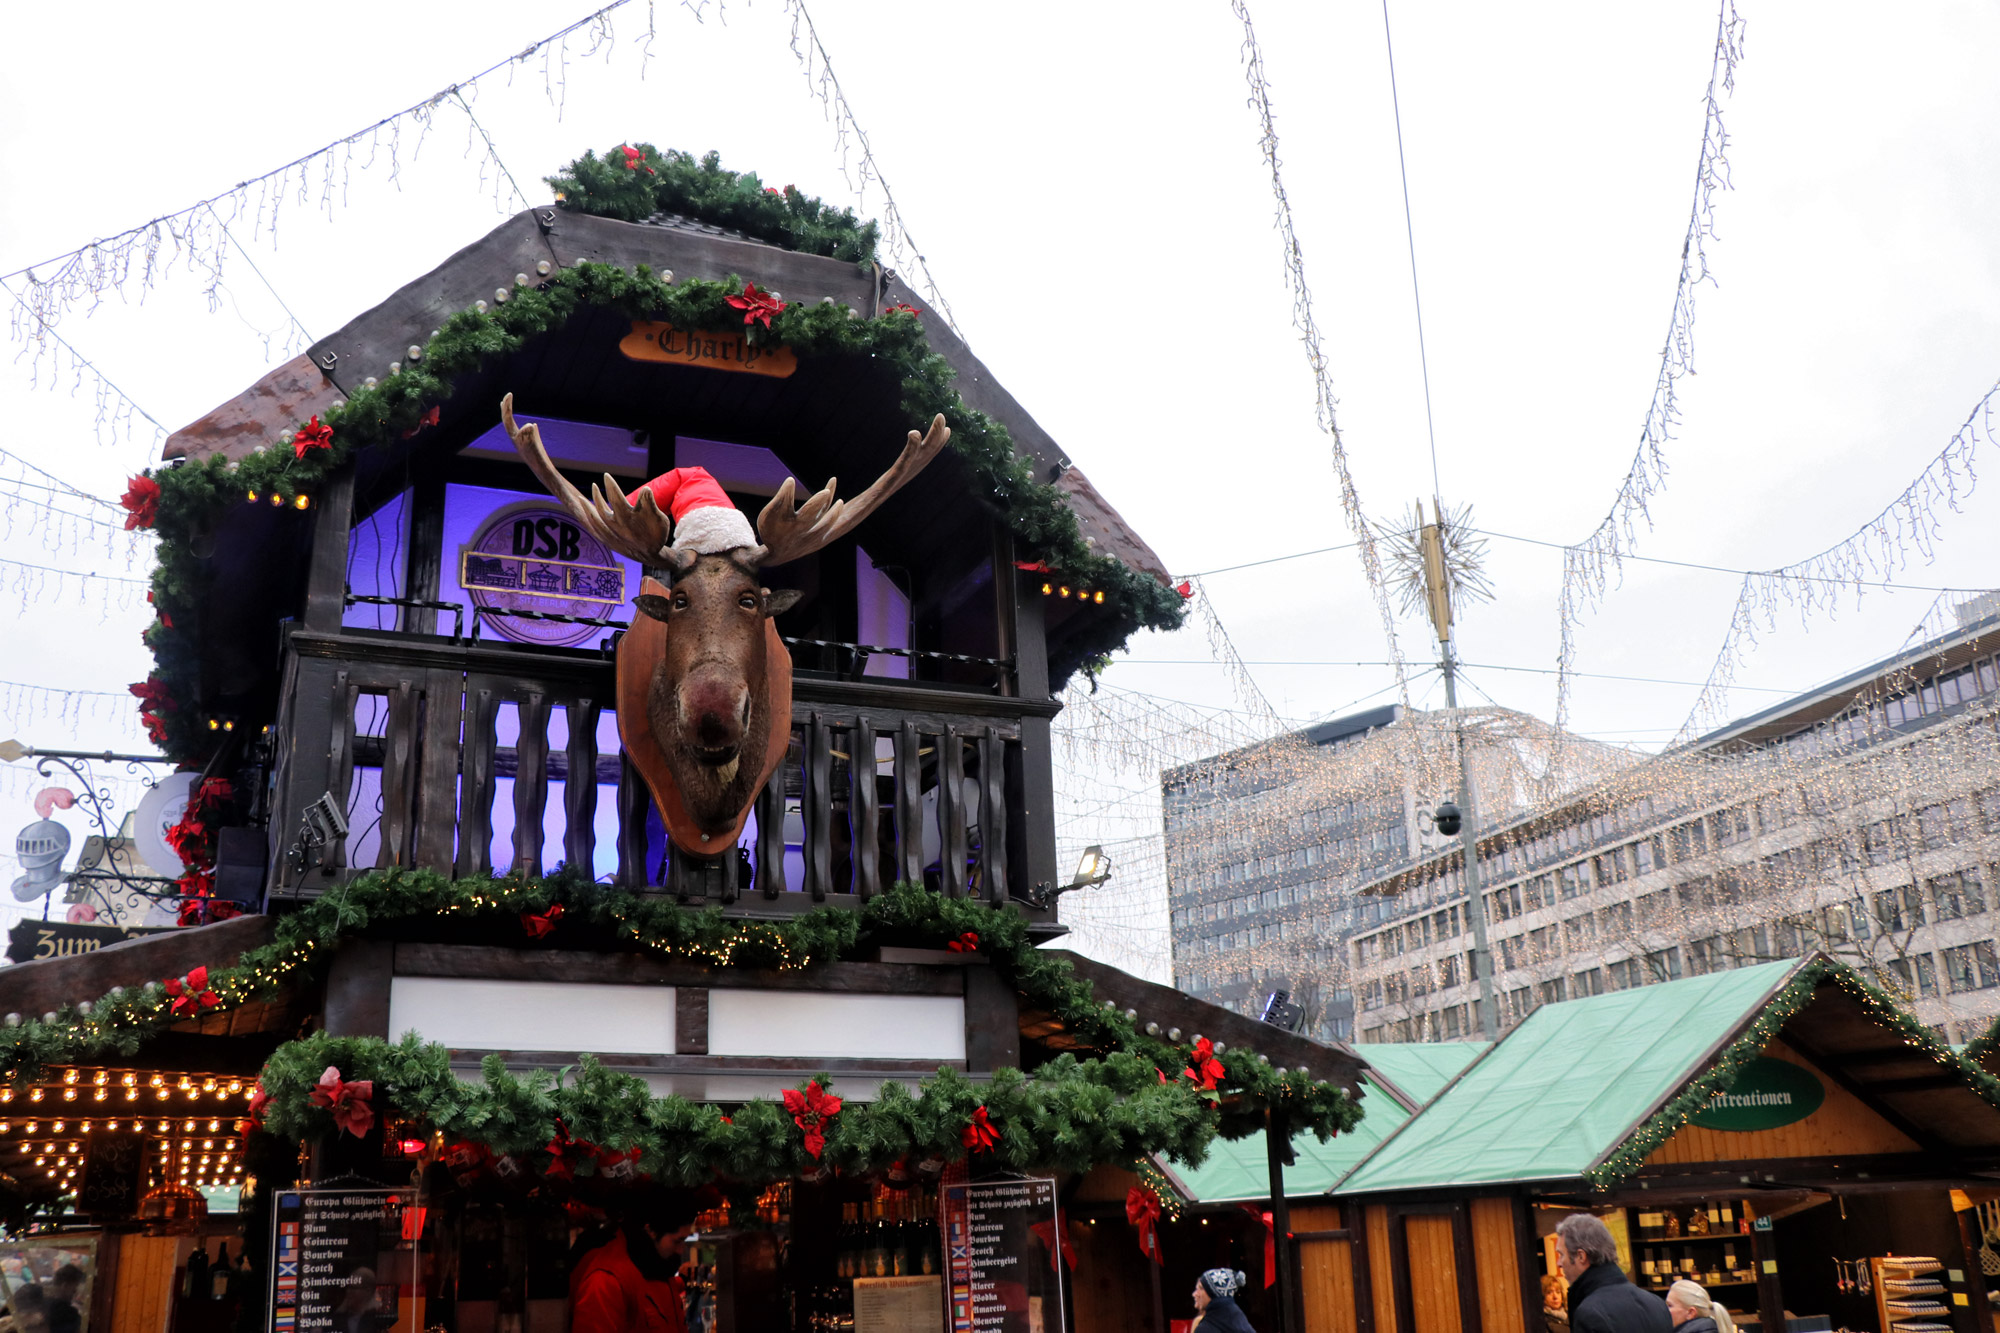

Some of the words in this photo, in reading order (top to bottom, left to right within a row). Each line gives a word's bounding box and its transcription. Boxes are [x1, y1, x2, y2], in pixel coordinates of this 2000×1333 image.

[658, 328, 761, 369] Charly
[512, 518, 581, 561] DSB
[33, 929, 101, 960] Zum
[965, 1189, 994, 1199] Europa
[995, 1187, 1031, 1198] Glühwein
[304, 1195, 341, 1208] Europa
[342, 1194, 386, 1208] Glühwein
[304, 1210, 318, 1220] mit
[320, 1209, 350, 1221] Schuss
[304, 1224, 327, 1234] Rum
[967, 1224, 1004, 1233] Cointreau
[303, 1237, 349, 1247] Cointreau
[967, 1235, 1001, 1244] Bourbon
[303, 1250, 344, 1260] Bourbon
[970, 1246, 994, 1256] Scotch
[970, 1256, 1018, 1268] Himbeergeist
[302, 1264, 334, 1275] Scotch
[970, 1270, 986, 1280] Gin
[301, 1276, 363, 1289] Himbeergeist
[970, 1282, 996, 1291] Klarer
[301, 1292, 321, 1301] Gin
[972, 1293, 998, 1303] Wodka
[300, 1305, 332, 1315] Klarer
[972, 1304, 1007, 1314] Amaretto
[300, 1317, 333, 1329] Wodka
[972, 1316, 1005, 1327] Genever
